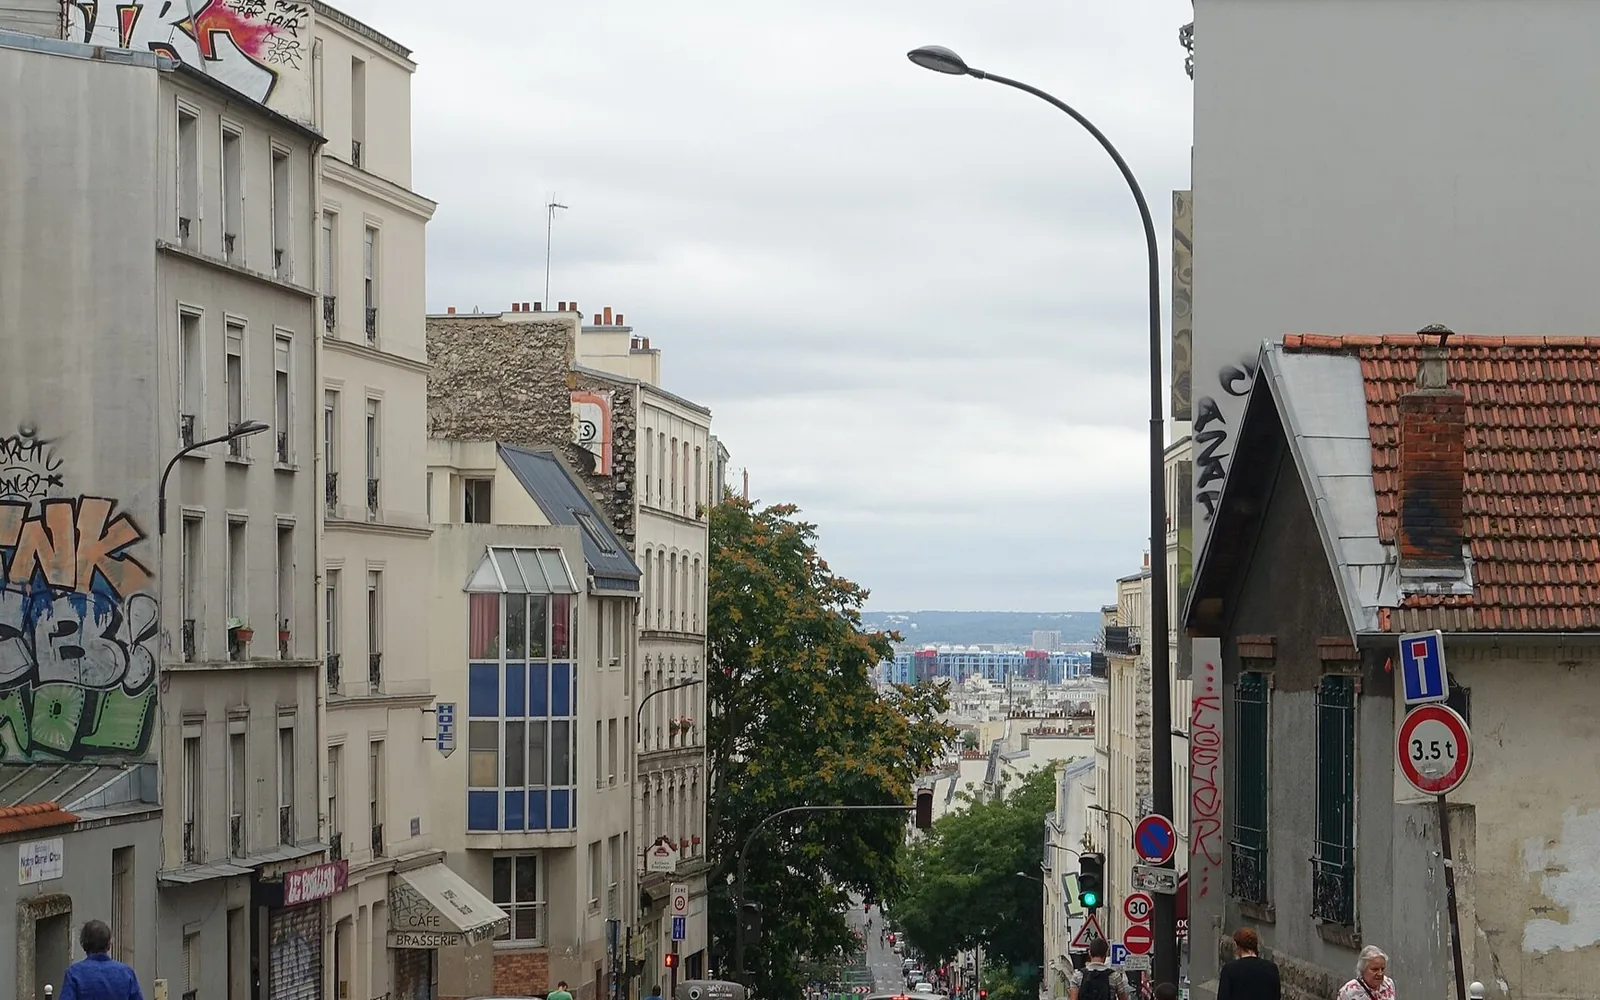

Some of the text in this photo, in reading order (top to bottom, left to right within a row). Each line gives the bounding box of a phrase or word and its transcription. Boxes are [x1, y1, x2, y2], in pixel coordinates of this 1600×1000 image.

[1412, 739, 1454, 761] 3.5 t
[1130, 902, 1148, 915] 30
[396, 934, 458, 947] BRASSERIE
[1116, 948, 1126, 962] P
